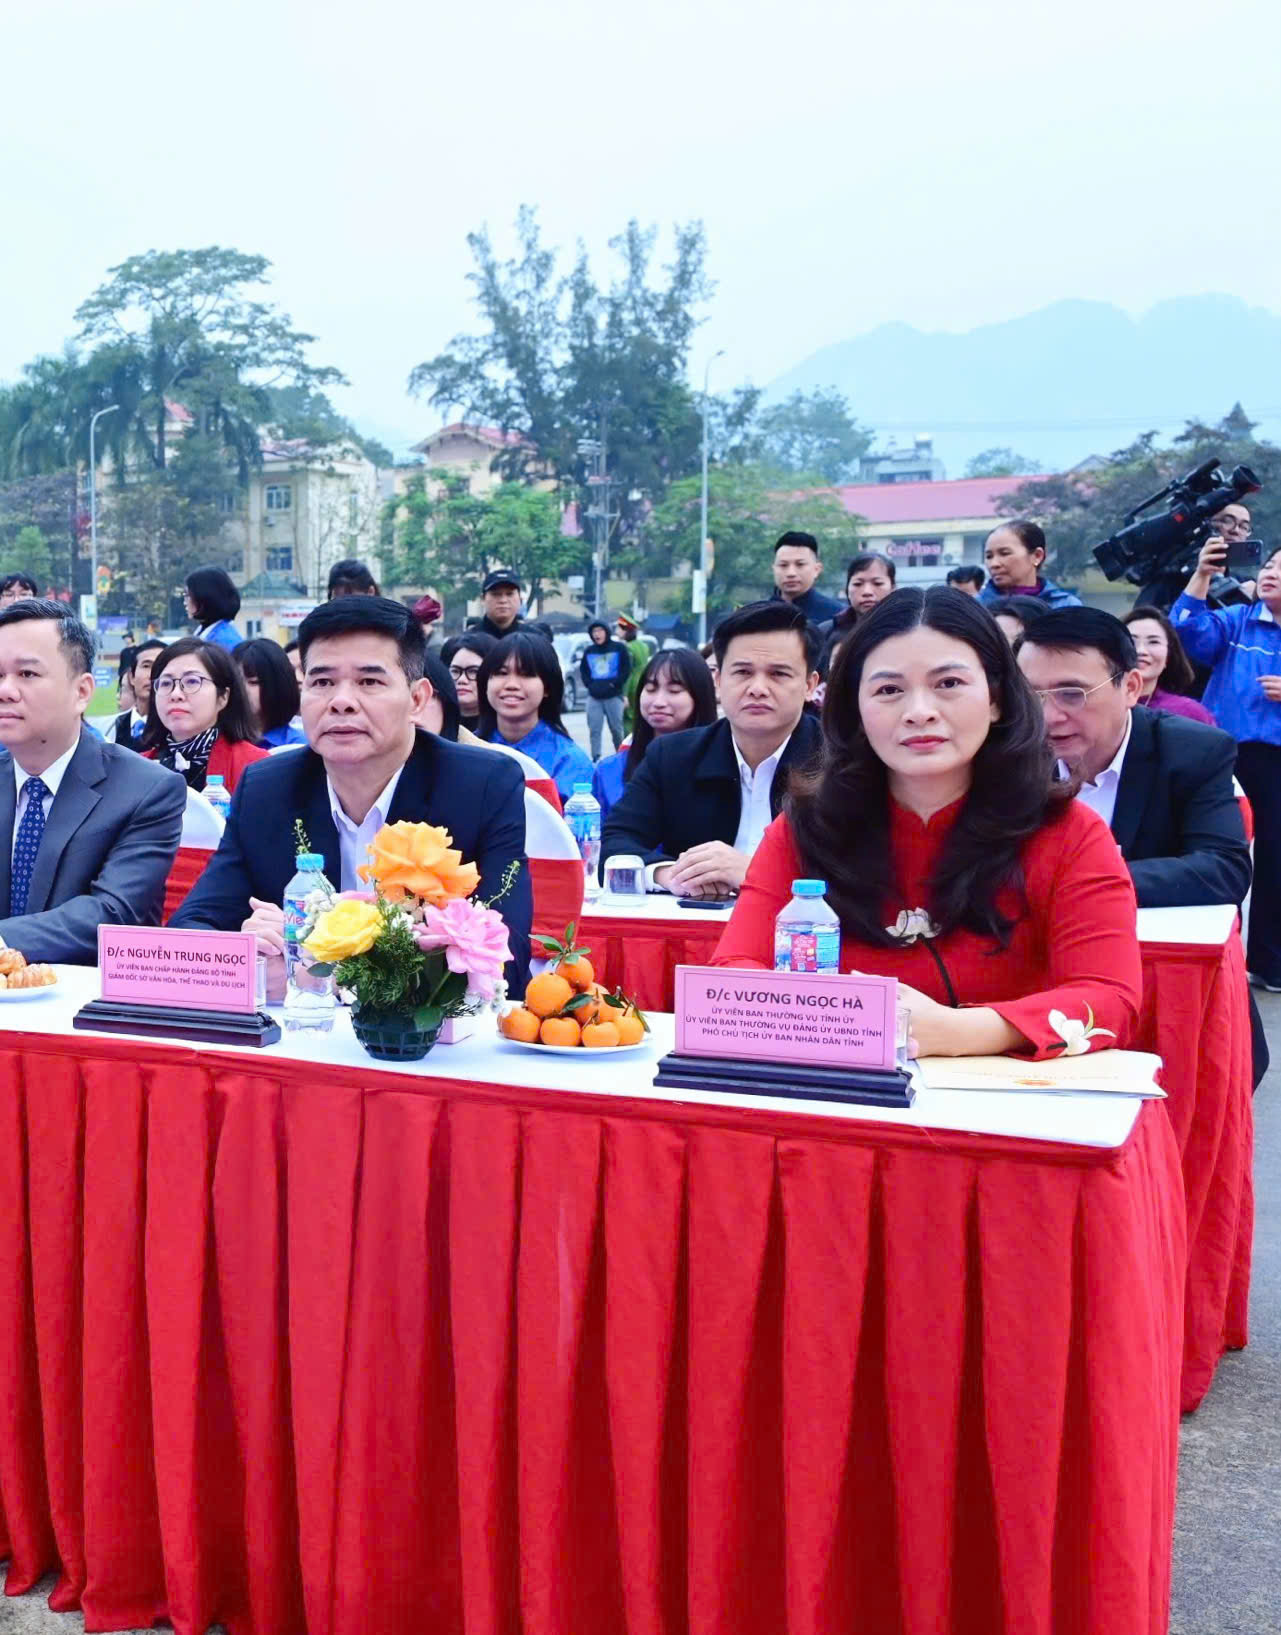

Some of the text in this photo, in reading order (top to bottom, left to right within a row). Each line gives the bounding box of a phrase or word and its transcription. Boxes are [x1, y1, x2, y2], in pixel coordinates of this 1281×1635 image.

[107, 945, 246, 966] Đ/c NGUYỄN TRUNG NGỌC
[126, 972, 138, 980] ĐỐC
[192, 967, 210, 976] ĐẢNG
[222, 969, 236, 977] TỈNH
[706, 988, 864, 1010] Đ/c VƯƠNG NGỌC HÀ
[712, 1005, 722, 1014] ỦY
[724, 1008, 744, 1016] VIÊN
[766, 1011, 804, 1020] THƯỜNG
[806, 1014, 818, 1022] VỤ
[820, 1013, 840, 1023] TỈNH
[842, 1014, 854, 1024] ỦY
[686, 1014, 696, 1023] ỦY
[698, 1016, 718, 1024] VIÊN
[792, 1022, 818, 1032] ĐẢNG
[820, 1024, 831, 1034] ỦY
[834, 1027, 859, 1036] UBND
[862, 1026, 882, 1038] TỈNH
[702, 1027, 720, 1036] PHÓ
[722, 1028, 738, 1038] CHỦ
[742, 1031, 759, 1040] TỊCH
[761, 1030, 772, 1040] ỦY
[795, 1034, 820, 1044] NHÂN
[822, 1036, 840, 1045] DÂN
[844, 1037, 864, 1047] TỈNH
